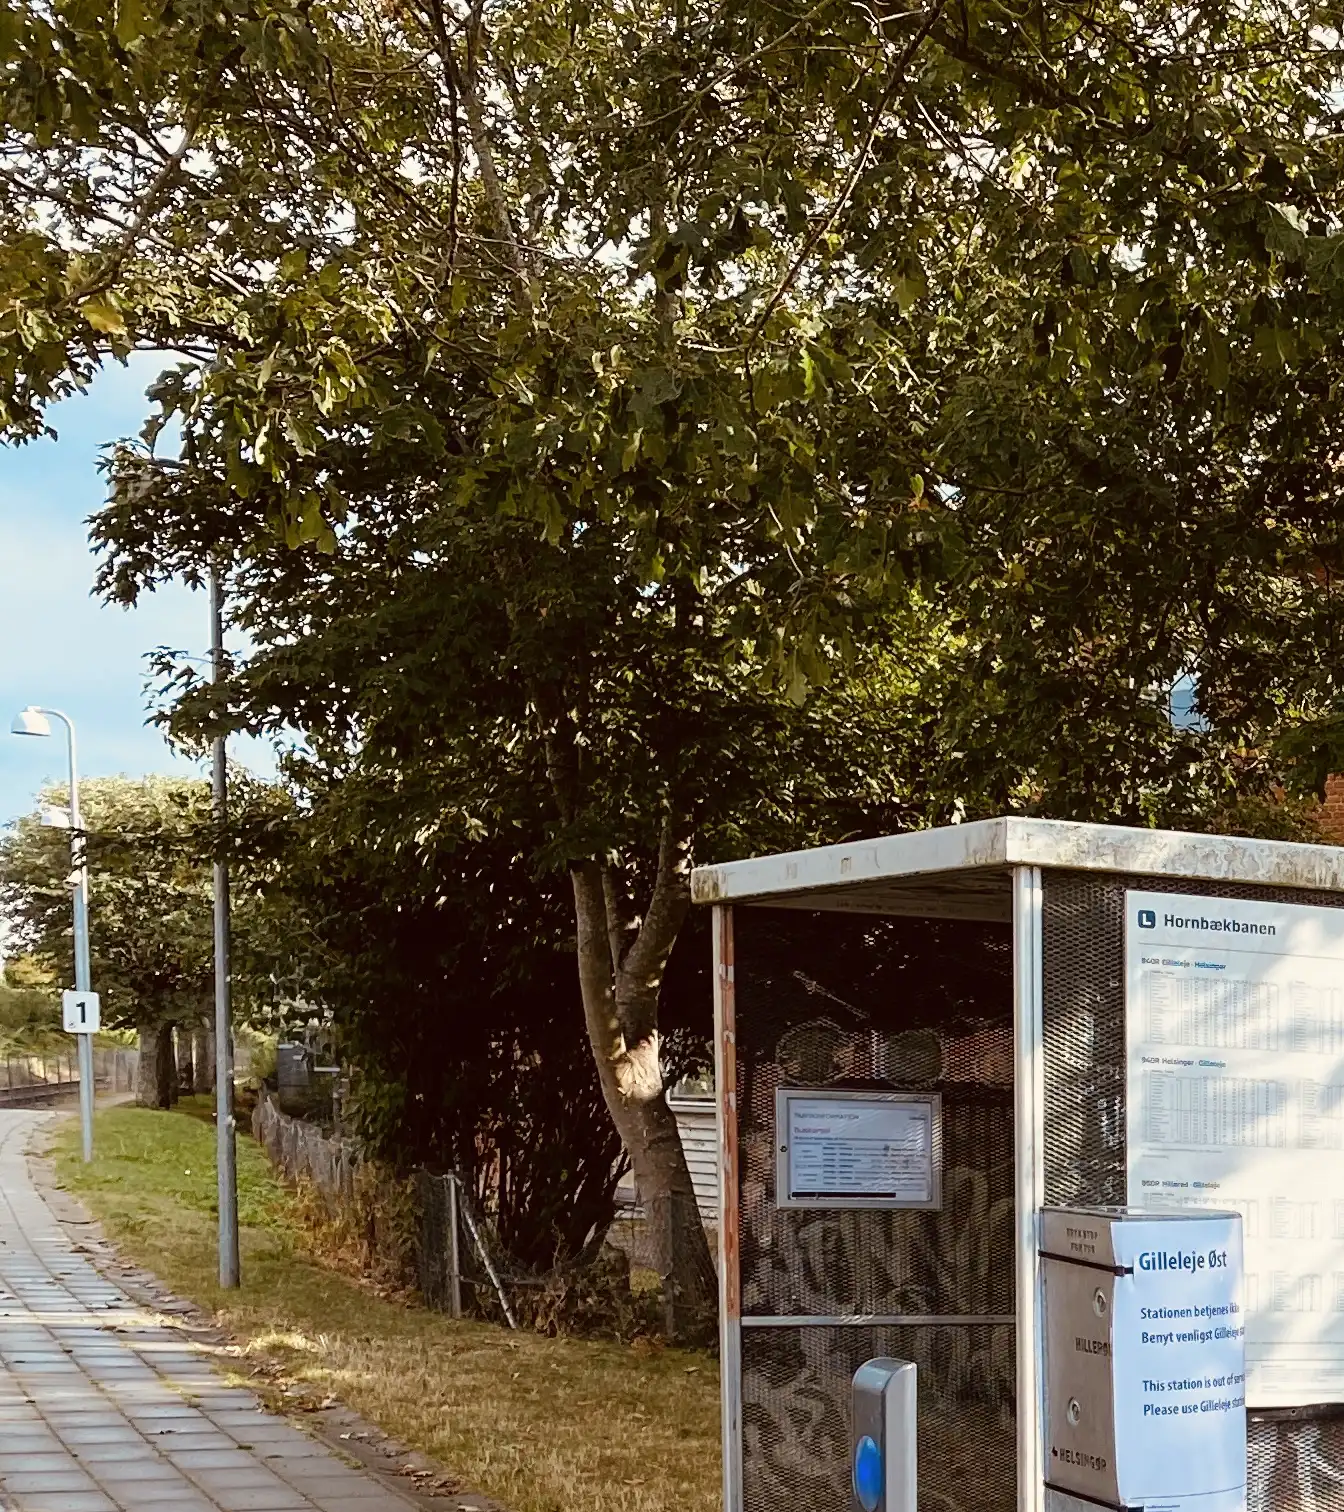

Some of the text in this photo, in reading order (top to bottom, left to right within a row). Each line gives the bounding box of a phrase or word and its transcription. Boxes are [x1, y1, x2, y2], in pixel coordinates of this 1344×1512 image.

[1163, 913, 1277, 936] Hornbækbanen
[76, 1001, 86, 1024] 1
[1139, 1248, 1227, 1274] Gilleleje Øst
[1140, 1306, 1193, 1320] Stationen
[1193, 1304, 1229, 1319] betjenes
[1141, 1331, 1174, 1347] Benyt
[1175, 1328, 1213, 1344] venligst
[1142, 1379, 1166, 1393] This
[1167, 1378, 1203, 1391] station
[1204, 1376, 1212, 1388] is
[1212, 1376, 1226, 1388] out
[1226, 1372, 1234, 1386] of
[1143, 1403, 1180, 1417] Please
[1181, 1404, 1199, 1414] use
[1200, 1398, 1231, 1413] Gilleleje
